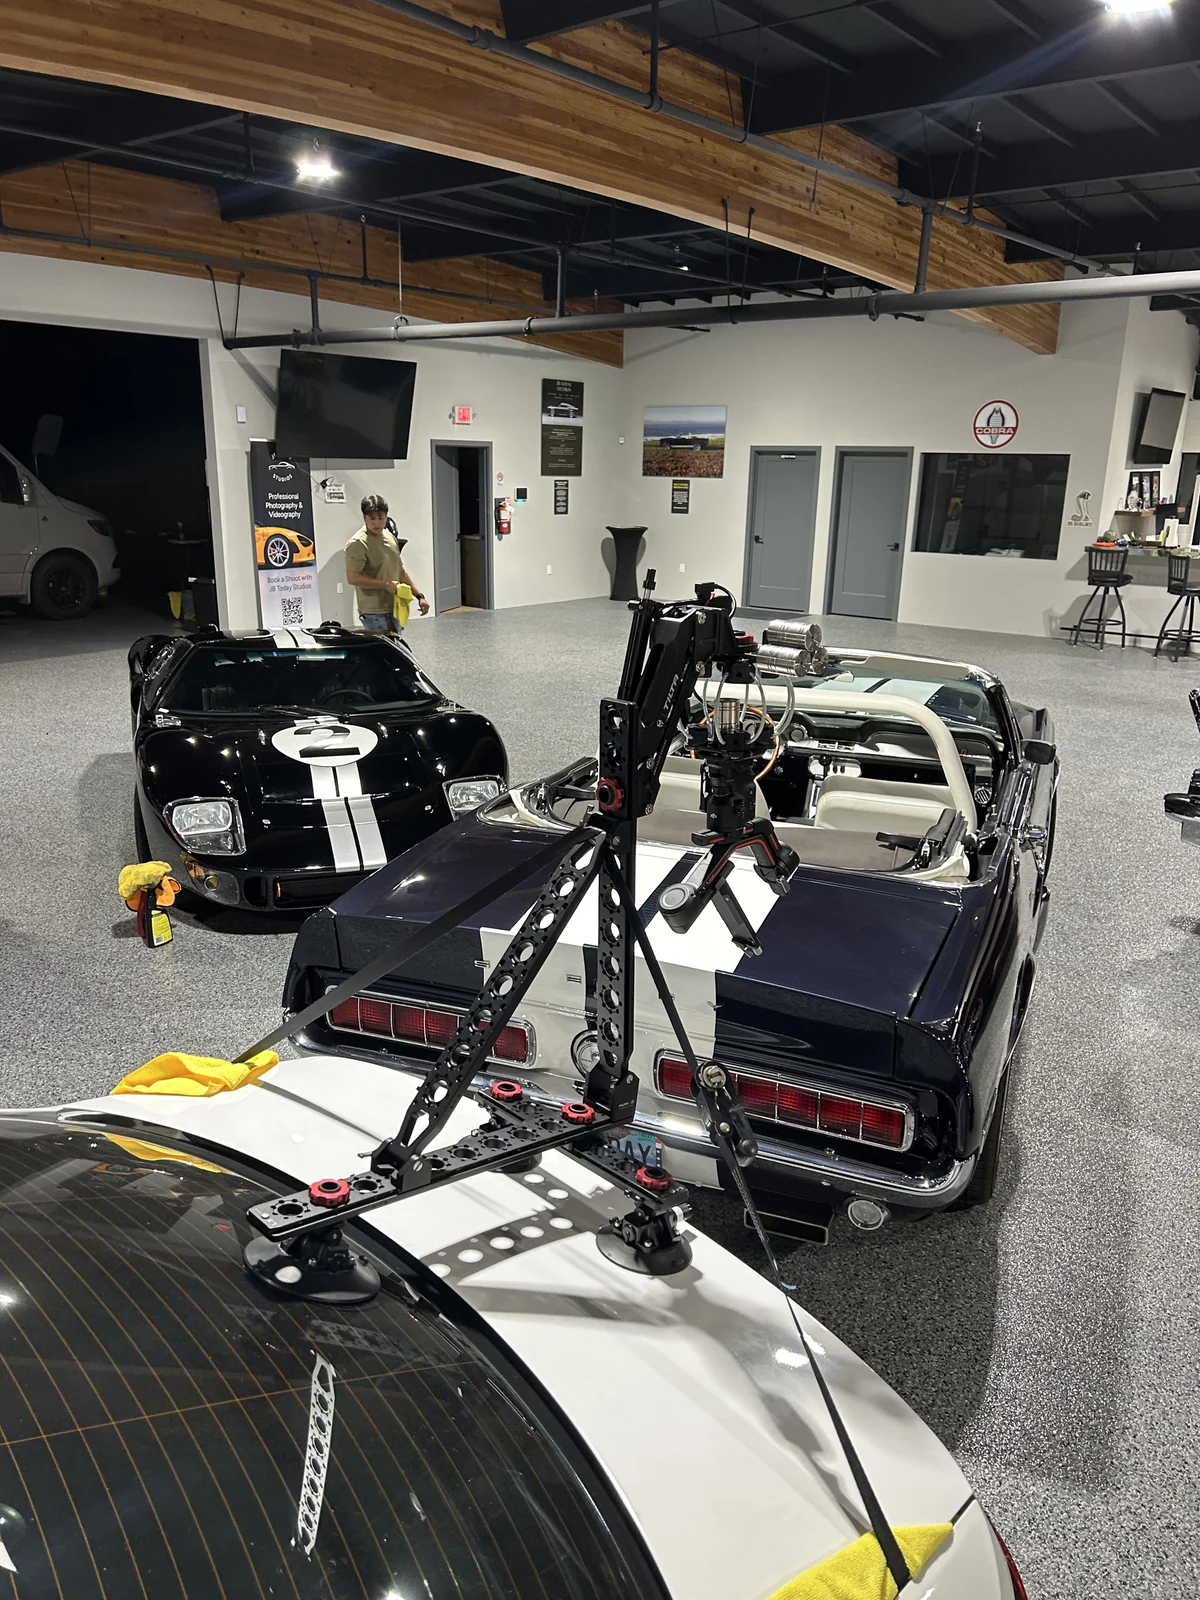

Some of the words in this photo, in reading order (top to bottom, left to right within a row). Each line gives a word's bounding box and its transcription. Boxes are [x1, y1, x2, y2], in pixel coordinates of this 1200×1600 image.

[272, 473, 293, 482] STUDIOS
[268, 492, 299, 500] Professional
[265, 501, 298, 510] Photography
[268, 510, 301, 519] Videography
[293, 583, 312, 591] Studios
[663, 673, 679, 710] TILTA
[294, 726, 361, 758] 2
